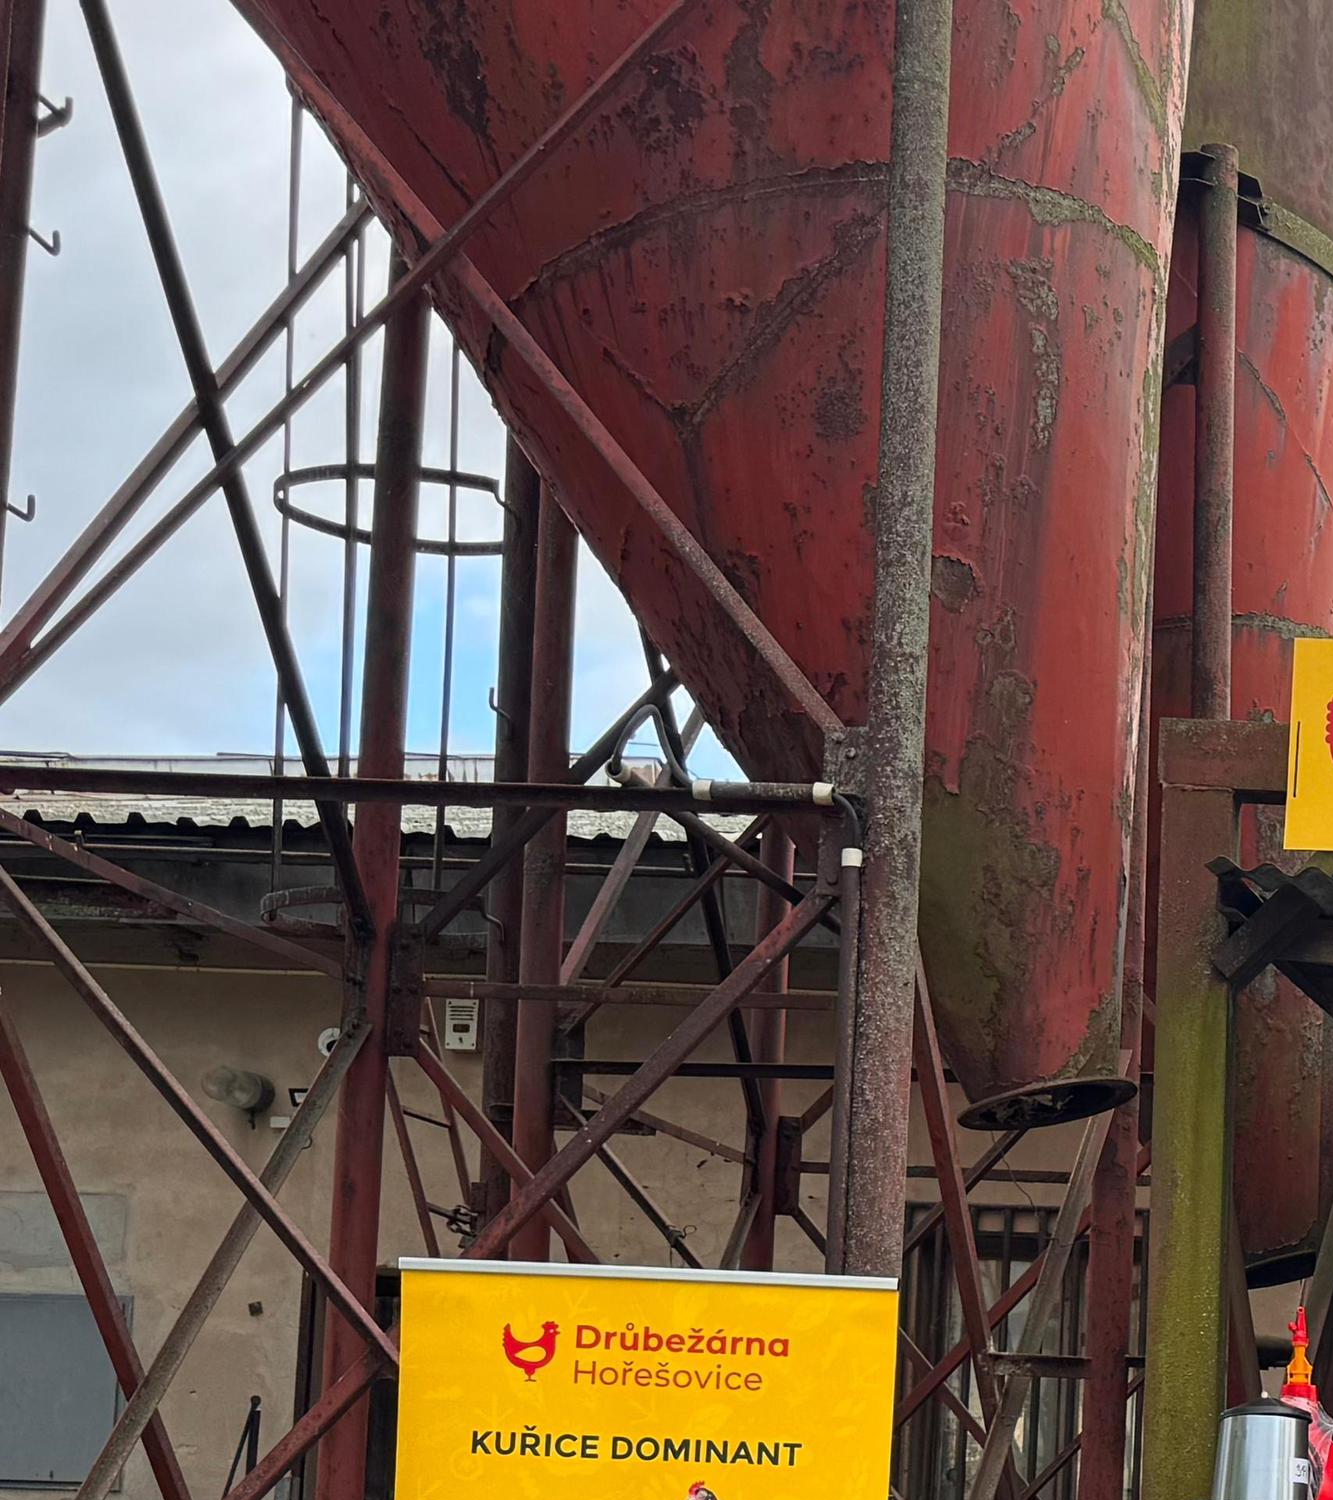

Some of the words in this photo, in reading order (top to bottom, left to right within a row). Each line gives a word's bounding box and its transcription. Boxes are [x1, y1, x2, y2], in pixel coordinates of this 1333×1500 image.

[575, 1322, 790, 1357] Drůbežárna
[573, 1360, 763, 1391] Hořešovice
[470, 1425, 600, 1460] KUŘICE
[611, 1435, 803, 1467] DOMINANT
